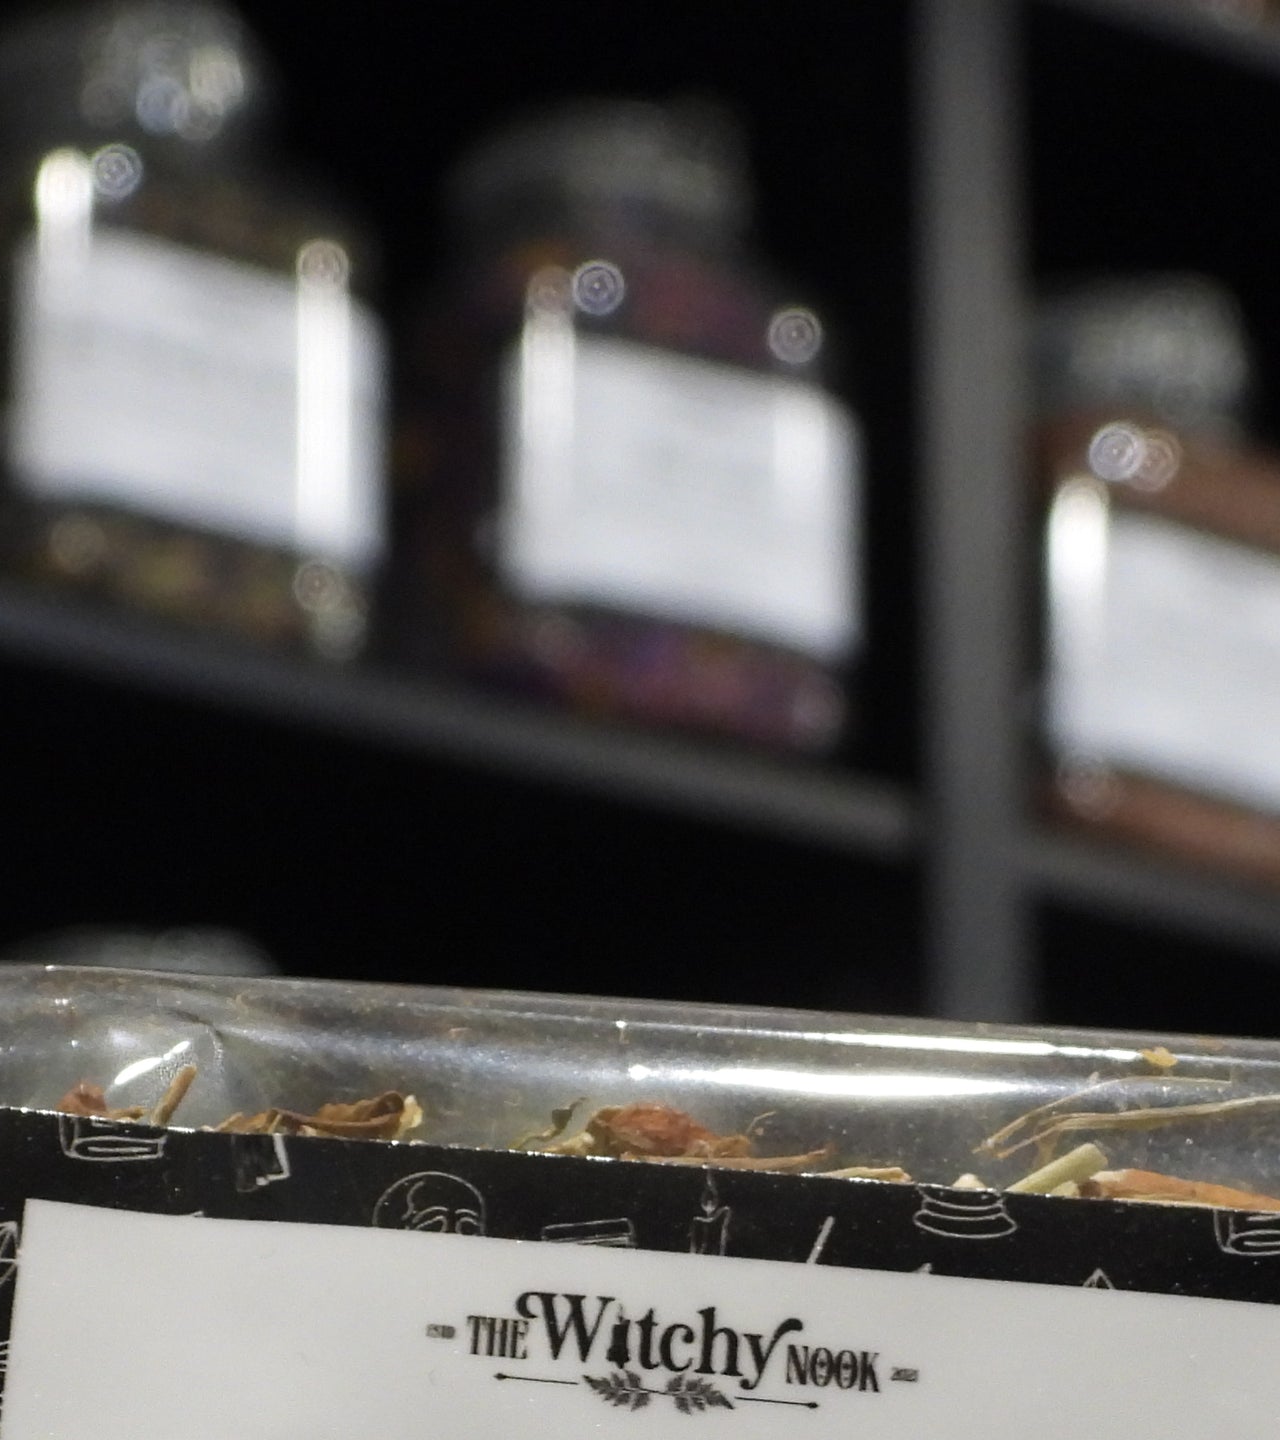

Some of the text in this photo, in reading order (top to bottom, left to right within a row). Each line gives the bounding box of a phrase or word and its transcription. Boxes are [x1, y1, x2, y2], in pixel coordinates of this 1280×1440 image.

[466, 1291, 881, 1393] THE Witchy NOOK
